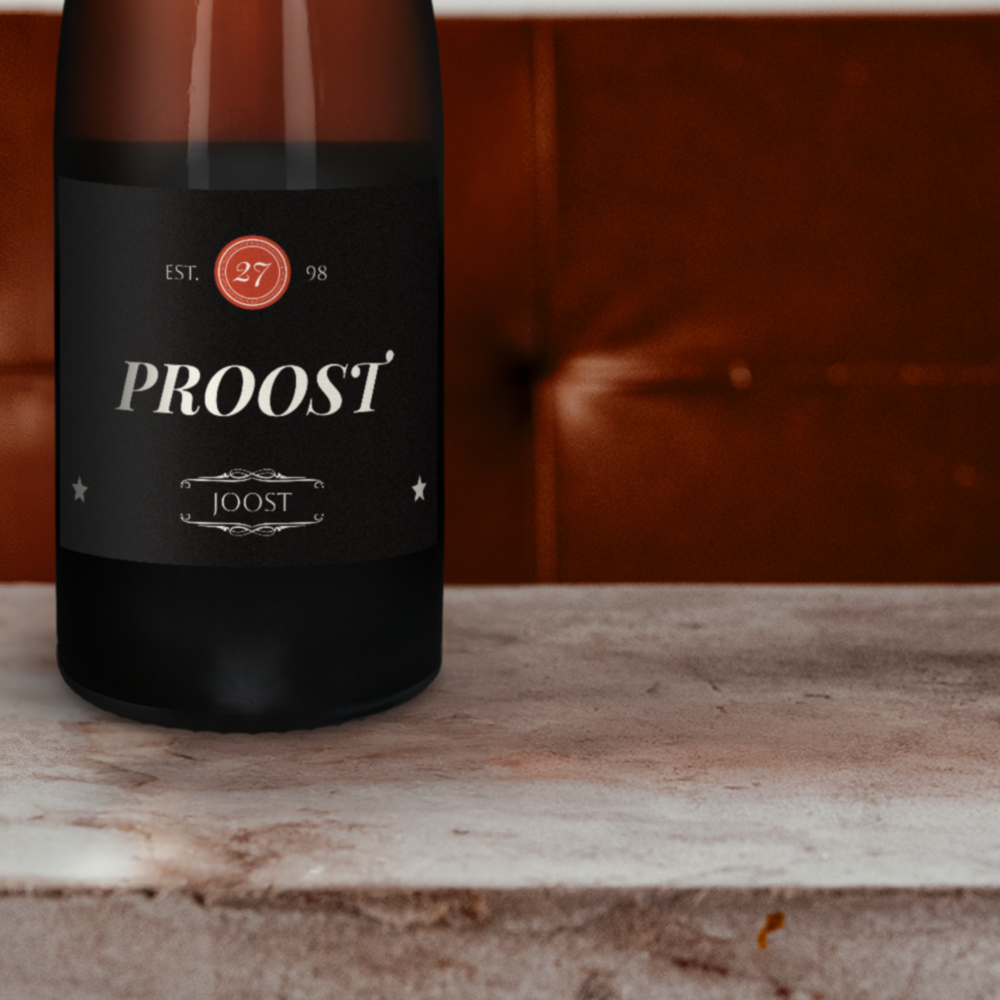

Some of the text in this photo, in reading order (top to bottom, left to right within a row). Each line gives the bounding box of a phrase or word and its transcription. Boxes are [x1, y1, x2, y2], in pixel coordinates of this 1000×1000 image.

[165, 260, 328, 288] EST. 27 98
[114, 349, 395, 417] PROOST
[212, 491, 293, 517] JOOST
